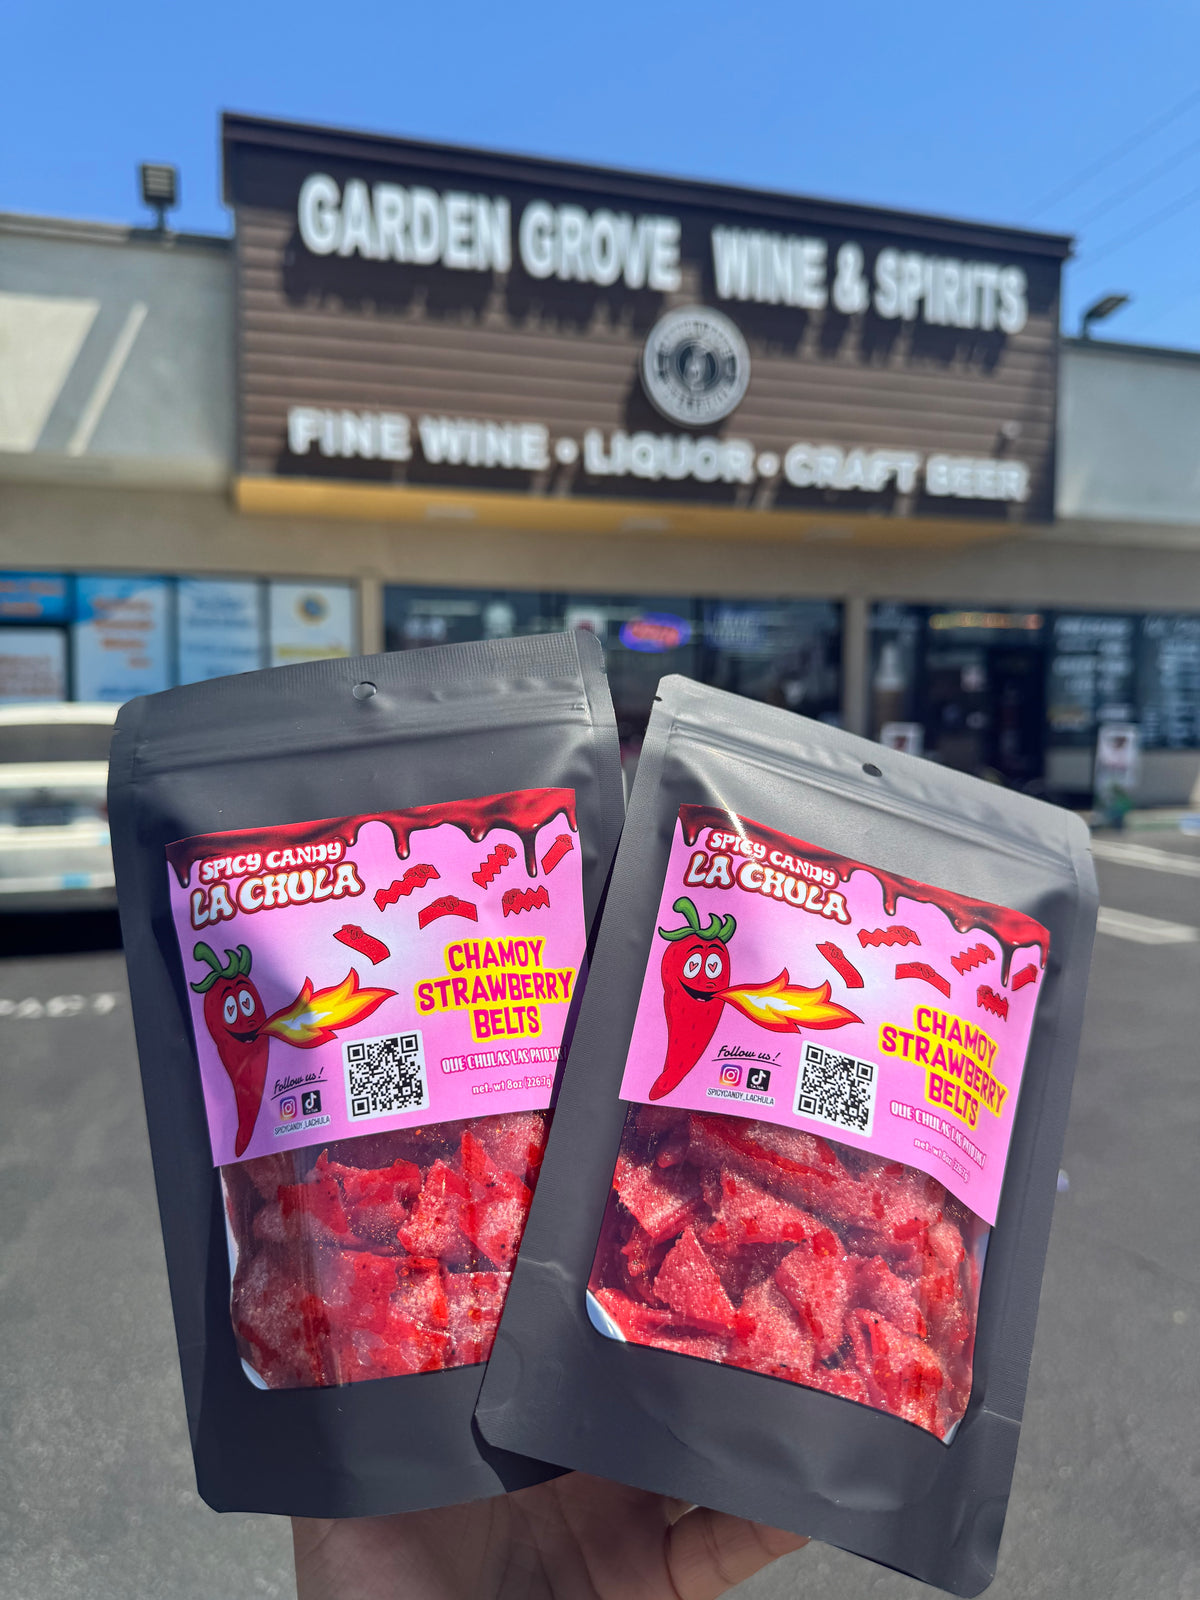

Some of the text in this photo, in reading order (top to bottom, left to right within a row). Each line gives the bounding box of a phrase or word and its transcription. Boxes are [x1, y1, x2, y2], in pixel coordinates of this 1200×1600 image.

[298, 173, 1028, 334] GARDEN GROVE WINE & SPIRITS
[287, 406, 1030, 501] FINE WINE LIQUOR CRAFT BEER
[201, 841, 342, 881] SPICY CANDY
[710, 832, 836, 887] SPICY CANDY
[191, 863, 362, 927] LA CHULA
[686, 853, 849, 923] LA CHULA
[447, 939, 544, 972] CHAMOY
[417, 970, 573, 1012] STRAWBERRY
[473, 1005, 540, 1039] BELTS
[916, 1007, 997, 1069] CHAMOY
[442, 1056, 466, 1074] QUE
[467, 1050, 510, 1069] CHULAS
[511, 1048, 529, 1065] LAS
[717, 1045, 756, 1058] Follow
[881, 1025, 1007, 1113] STRAWBERRY
[274, 1075, 304, 1094] Follow
[472, 1083, 492, 1095] net.
[493, 1081, 505, 1091] wt
[506, 1079, 523, 1090] 8oz
[707, 1087, 775, 1106] SPICYCANDY_LACHULA
[928, 1071, 979, 1127] BELTS
[890, 1100, 914, 1120] QUE
[914, 1108, 950, 1139] CHULAS
